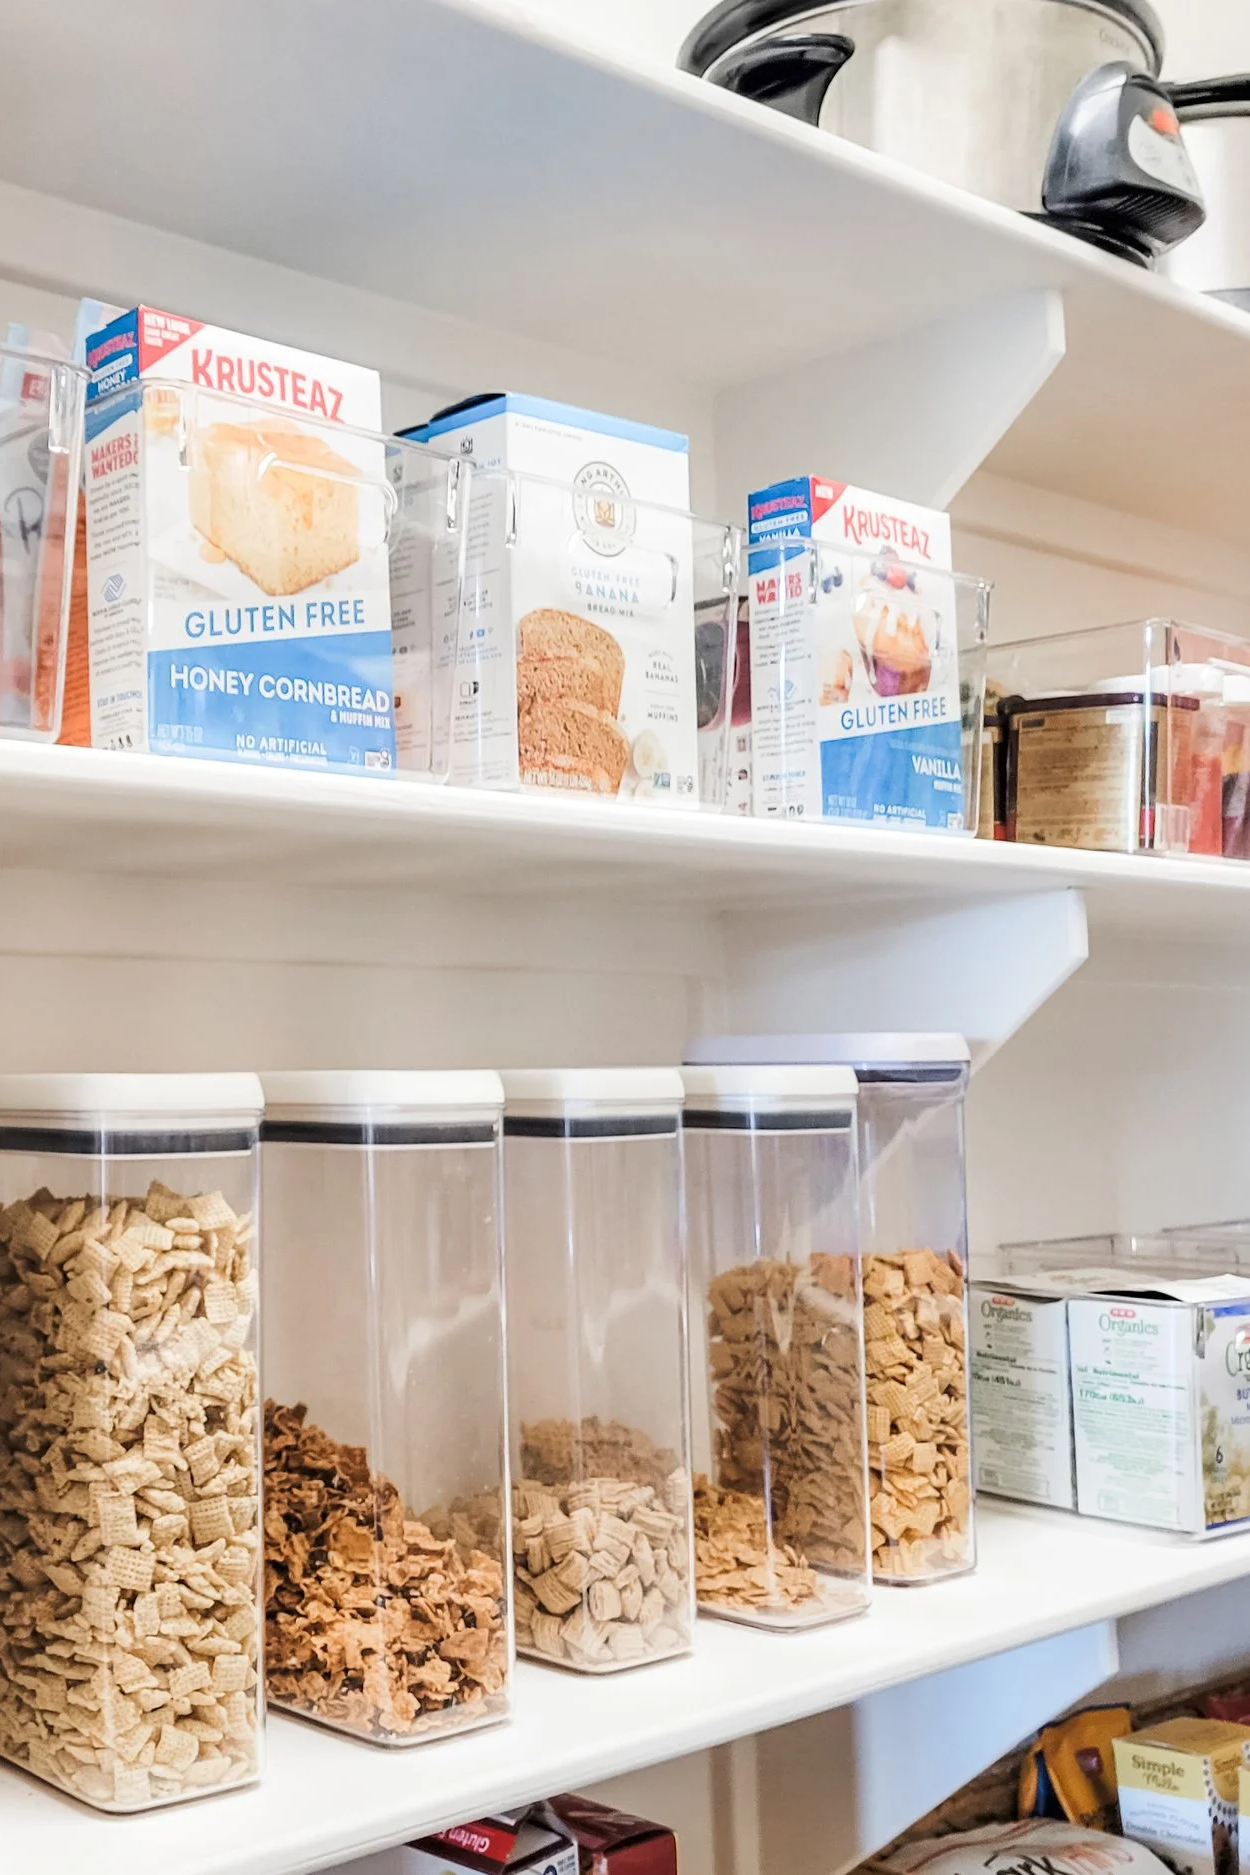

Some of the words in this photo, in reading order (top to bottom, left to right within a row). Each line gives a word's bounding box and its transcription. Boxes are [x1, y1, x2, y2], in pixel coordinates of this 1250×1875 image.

[191, 348, 346, 425] KRUSTEAZ
[91, 432, 132, 464] MAKERS
[92, 449, 133, 480] WANTED
[843, 505, 932, 560] KRUSTEAZ
[570, 566, 611, 583] GLUTEN
[615, 572, 641, 587] FREE
[575, 580, 640, 604] BANANA
[184, 604, 296, 638] GLUTEN
[306, 599, 365, 628] FREE
[587, 602, 617, 616] BREAD
[645, 671, 679, 684] BANANAS
[652, 660, 672, 673] REAL
[170, 664, 255, 696] HONEY
[258, 675, 390, 713] CORNBREAD
[339, 710, 373, 728] MUFFIN
[374, 714, 391, 729] MIX
[646, 711, 679, 723] MUFFINS
[841, 704, 908, 730] GLUTEN
[913, 697, 947, 719] FREE
[235, 733, 257, 749] NO
[259, 736, 328, 756] ARTIFICIAL
[912, 754, 962, 781] VANILLA
[874, 803, 886, 813] NO
[887, 804, 927, 818] ARTIFICIAL
[981, 1299, 1033, 1323] Organics
[1099, 1313, 1159, 1337] Organics
[1215, 1446, 1224, 1464] 6
[1131, 1754, 1185, 1778] Simple
[448, 1827, 491, 1853] Gluten
